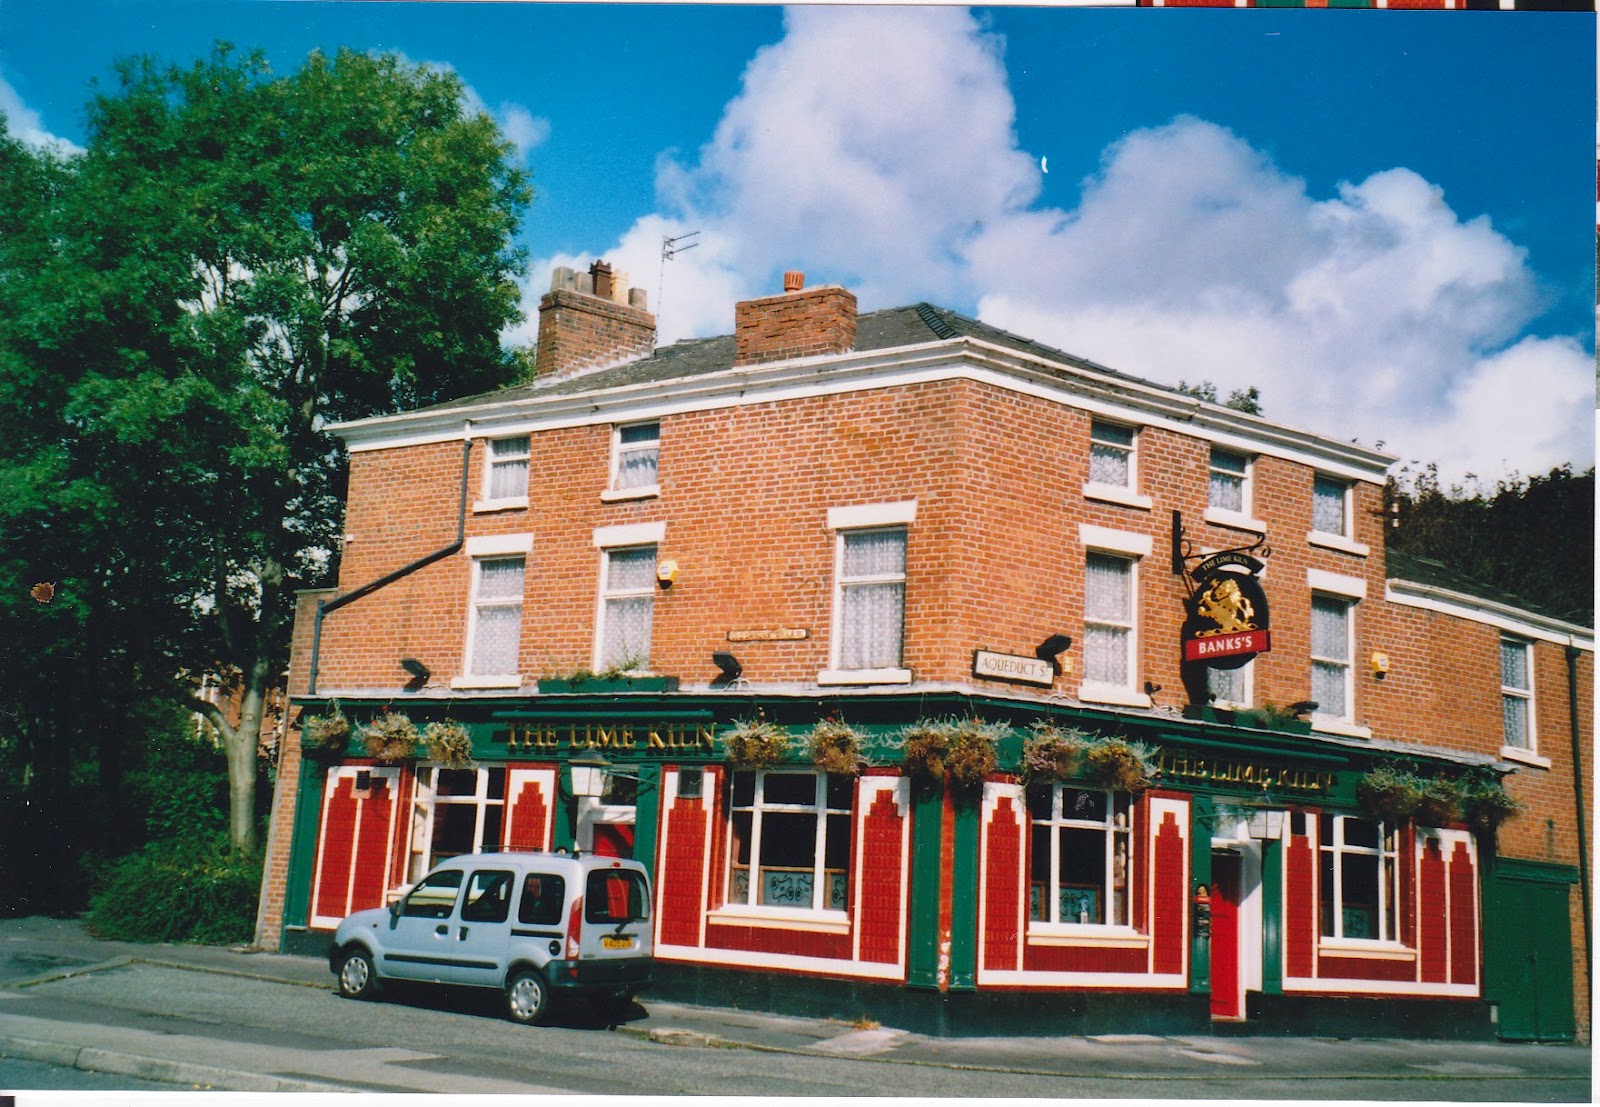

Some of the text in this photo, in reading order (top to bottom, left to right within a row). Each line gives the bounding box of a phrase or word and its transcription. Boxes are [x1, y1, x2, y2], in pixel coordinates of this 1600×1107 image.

[1202, 560, 1215, 571] THE
[1215, 554, 1231, 564] LIME
[1198, 636, 1252, 654] BANKS'S
[982, 657, 1036, 676] AQUEDUCT
[504, 720, 717, 749] THE LIME KILN
[1155, 748, 1334, 792] THE LIME KILN
